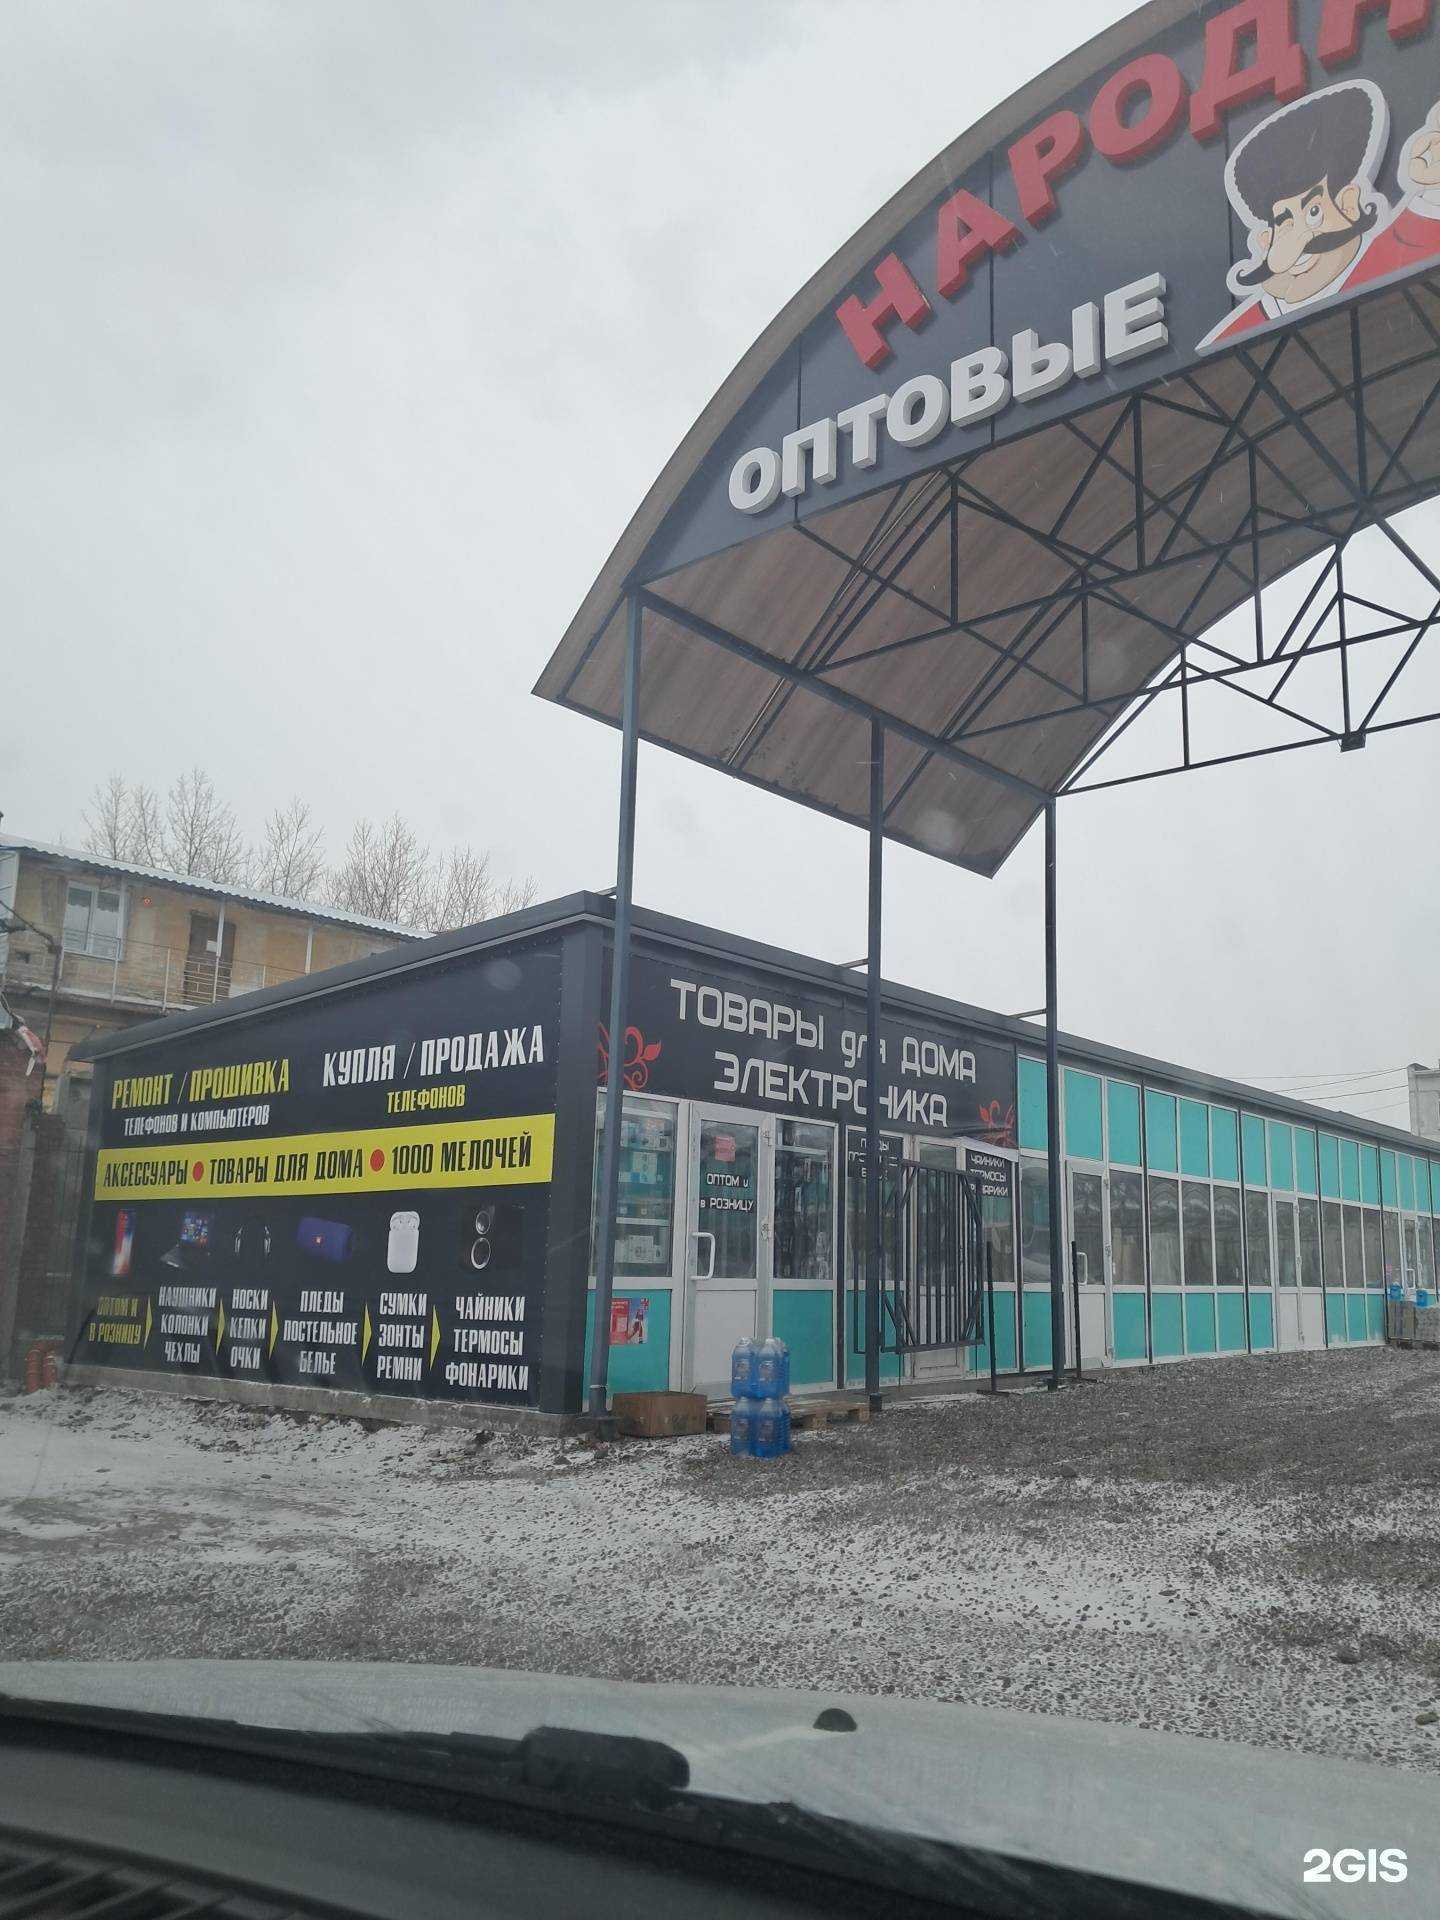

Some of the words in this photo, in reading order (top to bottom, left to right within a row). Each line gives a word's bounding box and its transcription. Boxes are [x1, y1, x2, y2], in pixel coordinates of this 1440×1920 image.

[728, 271, 1169, 514] ОПТОВЫЕ
[670, 978, 824, 1050] ТОВАРЫ
[901, 1036, 976, 1083] ДОМА
[323, 1044, 396, 1087] КУПЛЯ
[112, 1073, 173, 1110] РЕМОНТ
[387, 1084, 466, 1113] ТЕЛЕФОНОВ
[124, 1114, 178, 1136] ТЕЛЕФОНОВ
[181, 1112, 188, 1132] И
[190, 1104, 270, 1131] КОМПЬЮТЕРОВ
[104, 1160, 188, 1187] АКСЕССУАРЫ
[209, 1155, 268, 1185] ТОВАРЫ
[274, 1151, 309, 1182] ДЛЯ
[314, 1149, 363, 1181] ДОМА
[392, 1143, 434, 1174] 1000
[440, 1131, 532, 1172] МЕЛОЧЕЙ
[706, 1173, 740, 1187] ОПТОМ
[709, 1197, 754, 1212] РОЗНИЦУ
[158, 1286, 217, 1308] НАУШНИКИ
[231, 1288, 269, 1310] НОСКИ
[300, 1290, 344, 1313] ПЛЕДЫ
[379, 1292, 428, 1317] СУМКИ
[455, 1293, 526, 1321] ЧАЙНИКИ
[88, 1322, 96, 1341] В
[98, 1322, 142, 1344] РОЗНИЦУ
[160, 1314, 210, 1336] КОЛОНКИ
[229, 1317, 267, 1339] КЕПКИ
[283, 1319, 358, 1345] ПОСТЕЛЬНОЕ
[378, 1323, 425, 1349] ЗОНТЫ
[164, 1341, 200, 1363] ЧЕХЛЫ
[453, 1328, 524, 1356] ТЕРМОСЫ
[230, 1345, 261, 1370] ОЧКИ
[299, 1350, 336, 1375] БЕЛЬЕ
[376, 1355, 423, 1381] РЕМНИ
[445, 1361, 529, 1391] ФОНАРИКИ
